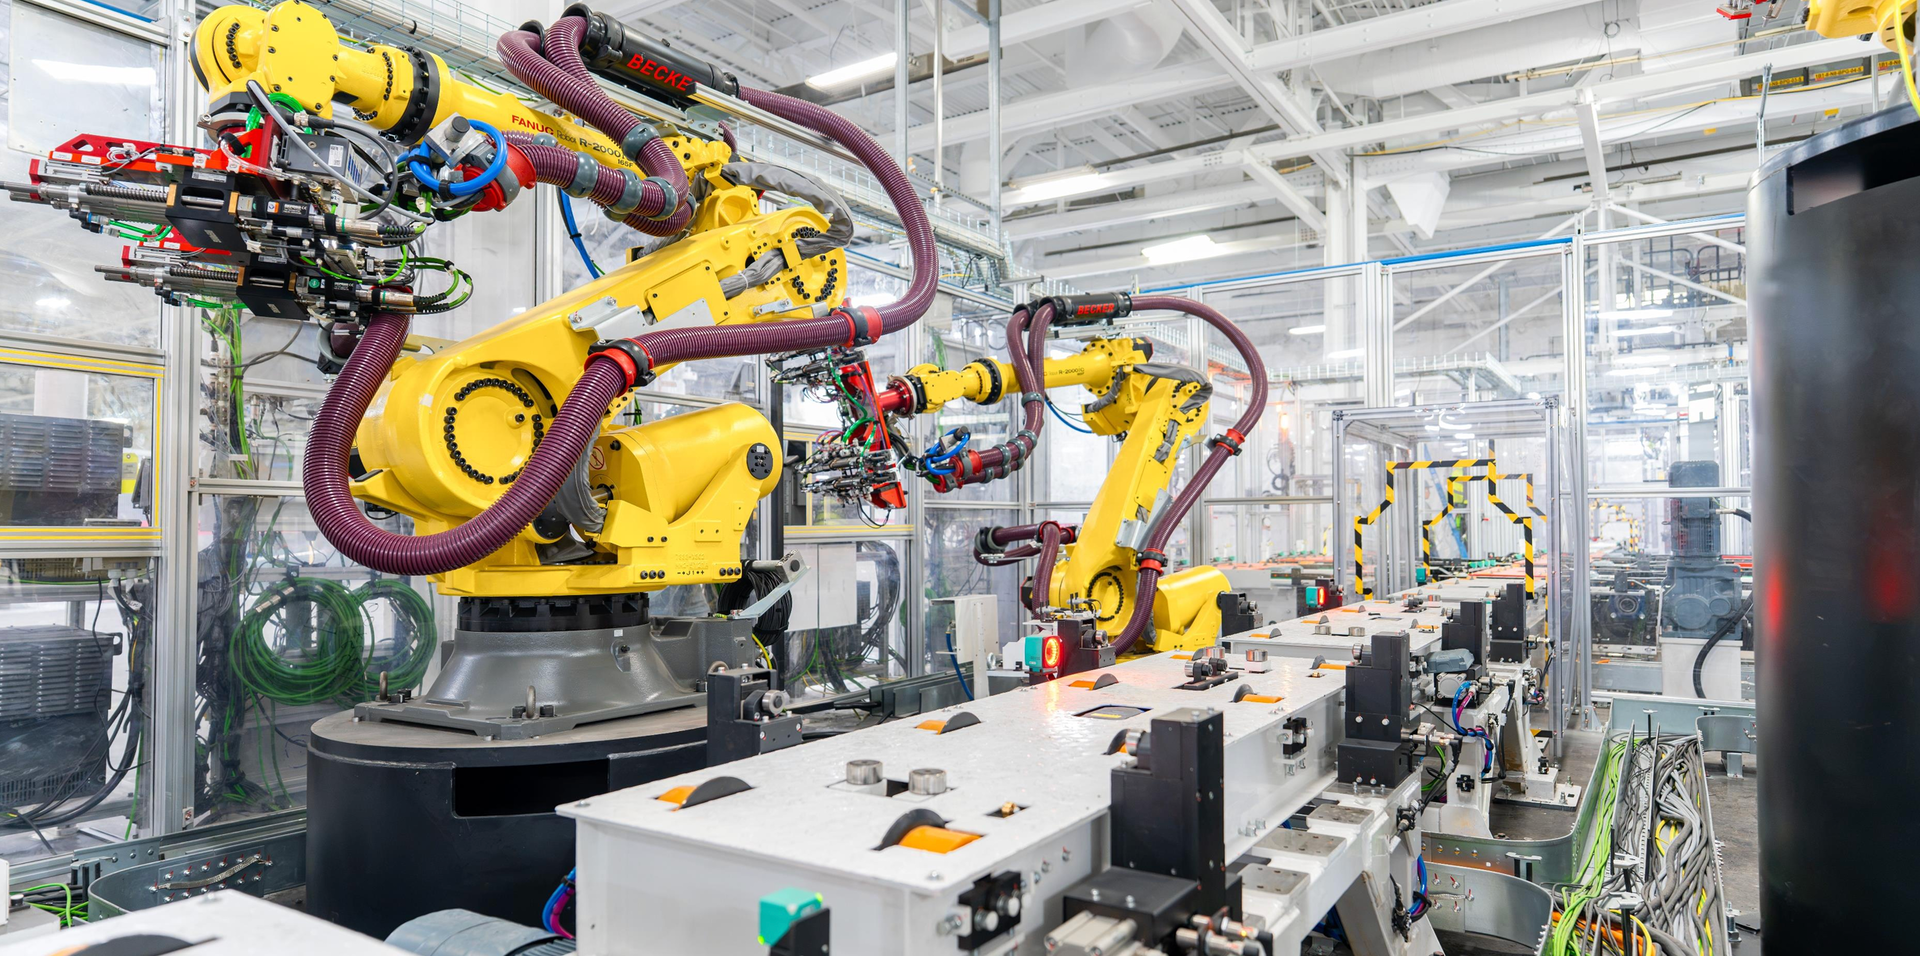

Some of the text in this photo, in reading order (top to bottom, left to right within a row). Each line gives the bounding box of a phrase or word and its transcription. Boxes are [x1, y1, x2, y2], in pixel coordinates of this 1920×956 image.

[626, 53, 697, 92] BECKE
[511, 115, 554, 135] FANUC
[557, 130, 577, 143] Robot
[1077, 303, 1115, 315] BECKER
